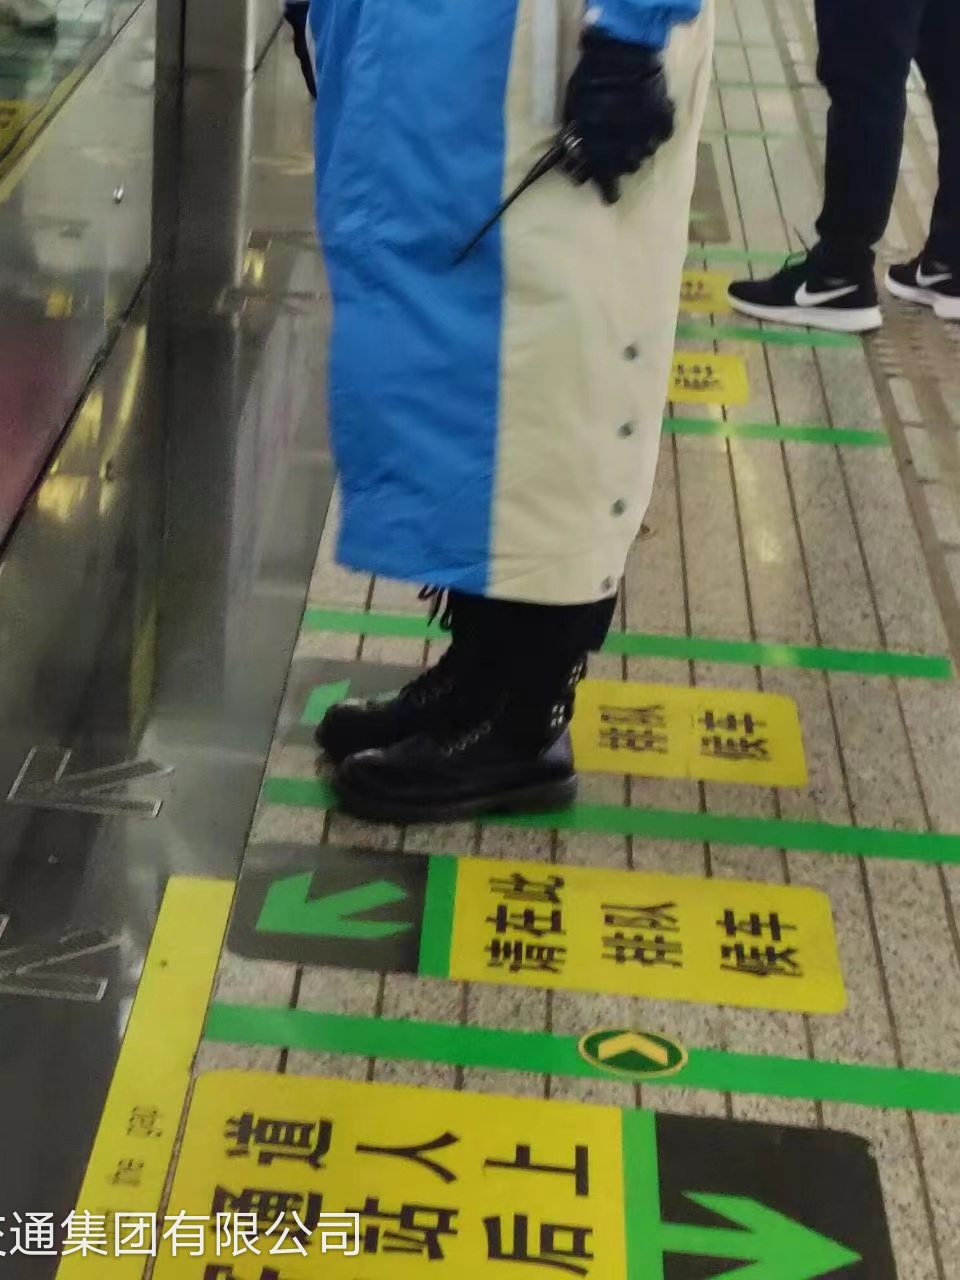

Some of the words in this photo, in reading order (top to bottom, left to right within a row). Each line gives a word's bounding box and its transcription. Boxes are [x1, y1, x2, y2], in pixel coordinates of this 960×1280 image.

[597, 703, 670, 756] 排队
[698, 707, 774, 763] 候车
[484, 872, 568, 974] 请在此
[600, 900, 683, 968] 排队
[715, 908, 805, 978] 候车
